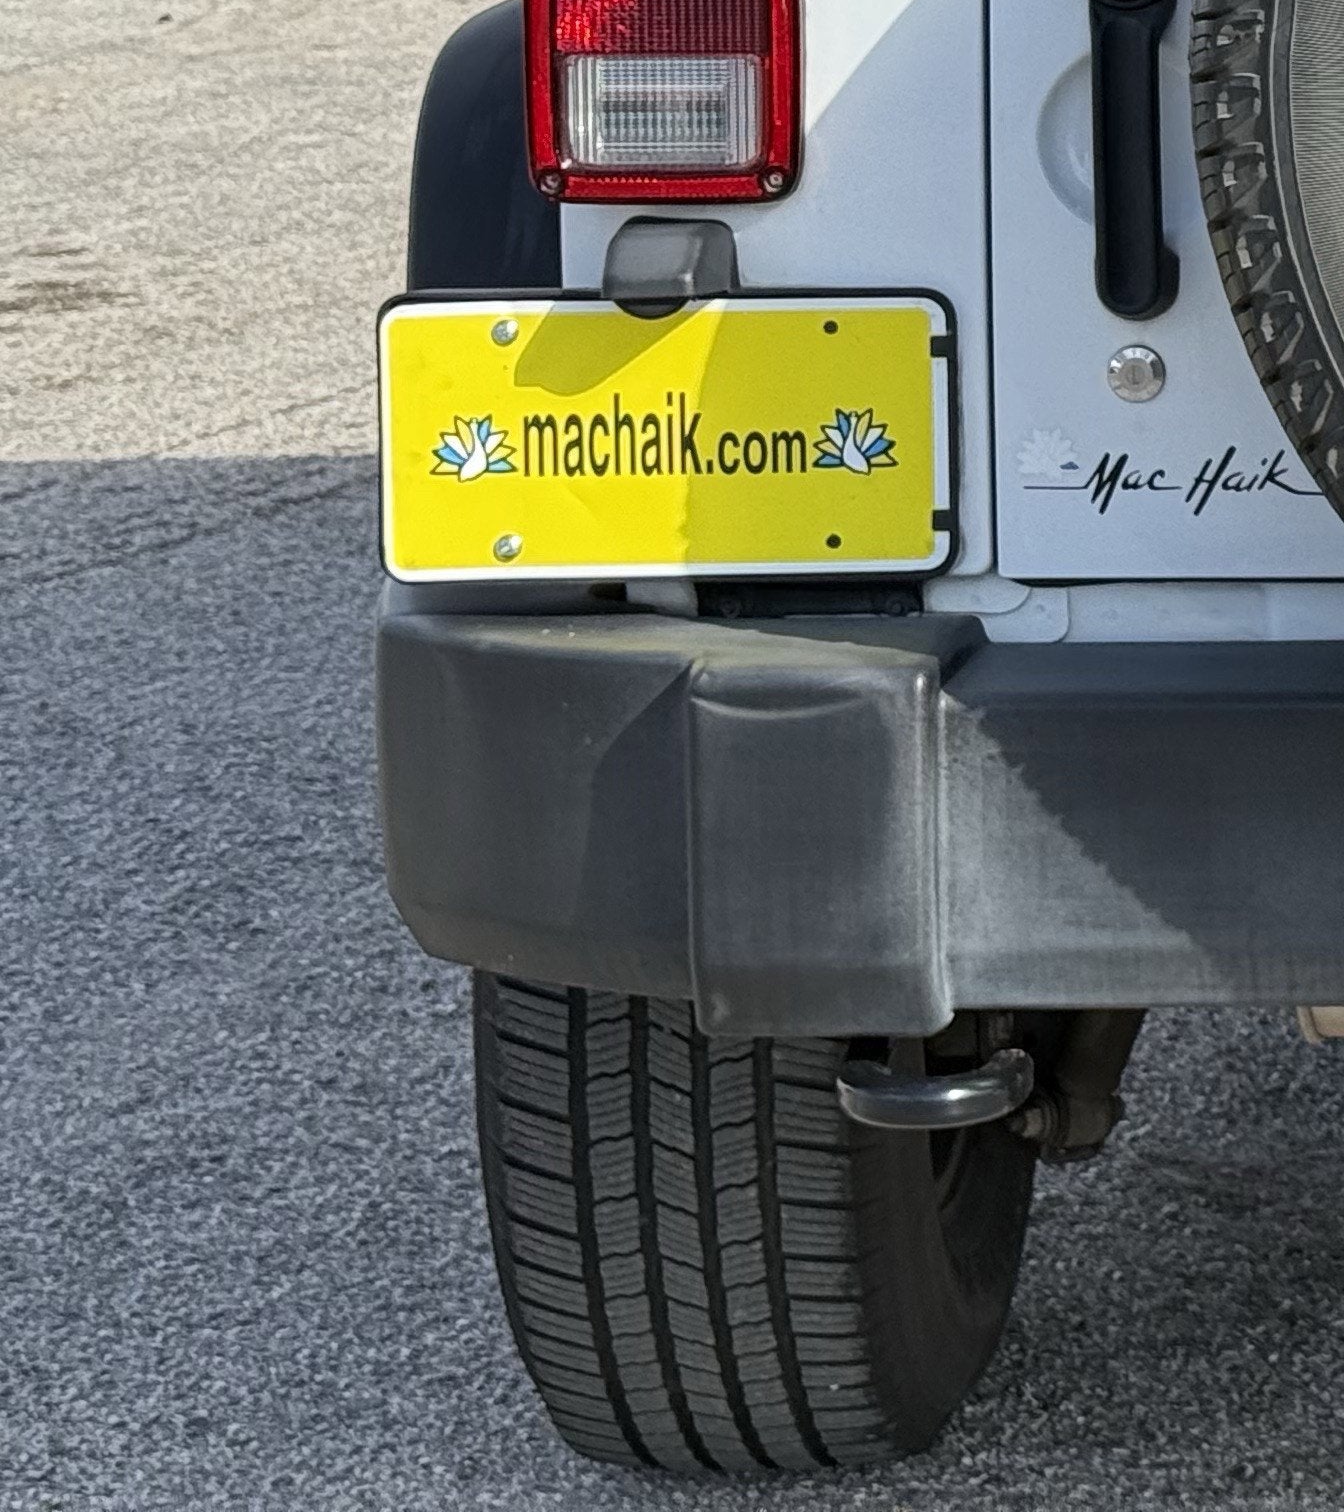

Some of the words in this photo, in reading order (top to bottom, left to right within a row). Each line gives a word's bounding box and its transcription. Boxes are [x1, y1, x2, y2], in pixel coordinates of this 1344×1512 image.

[523, 391, 808, 476] machaik.com
[1084, 452, 1182, 515] Mac
[1185, 445, 1324, 515] Haik
